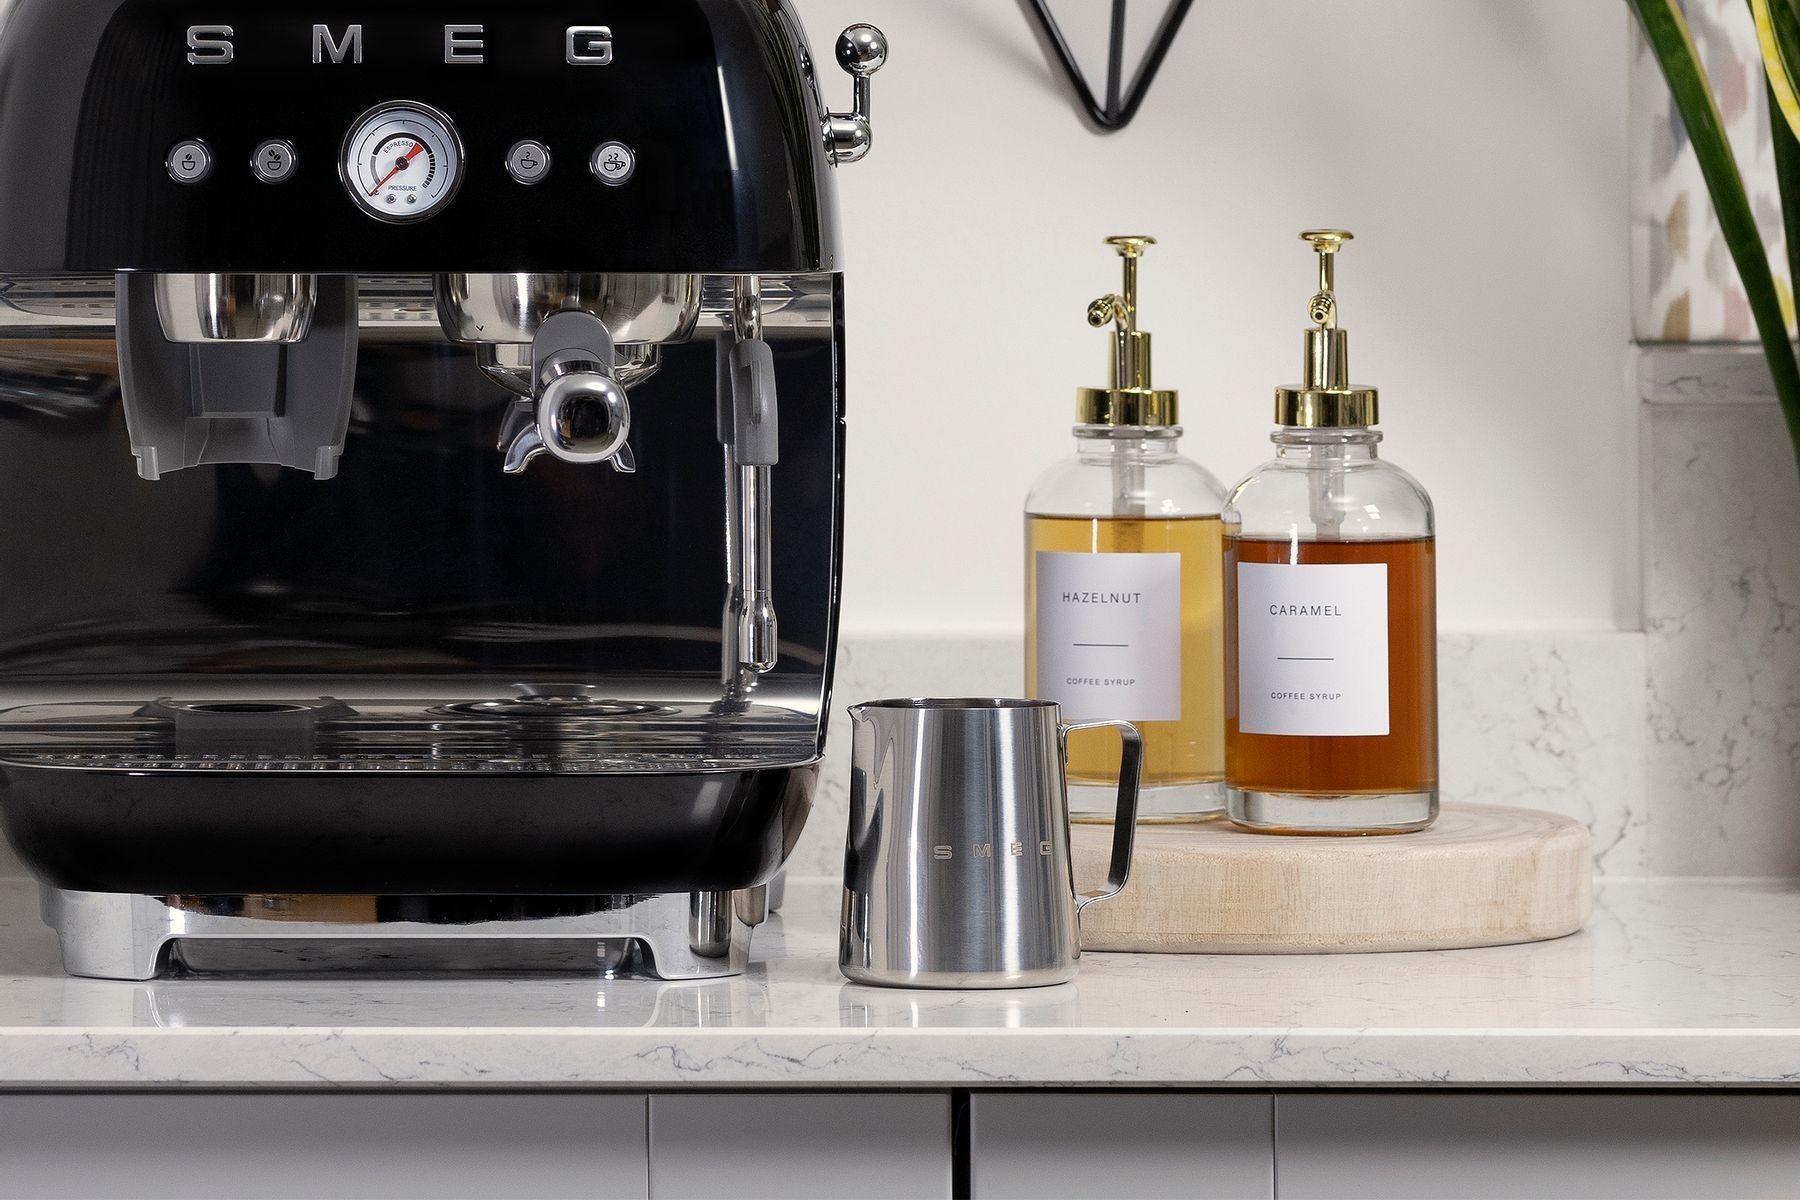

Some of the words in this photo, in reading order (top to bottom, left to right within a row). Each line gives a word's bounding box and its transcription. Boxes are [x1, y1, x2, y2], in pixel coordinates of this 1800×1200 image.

[187, 23, 613, 66] SMEG
[383, 140, 414, 154] ESPRESSO
[1062, 591, 1142, 605] HAZELNUT
[1269, 604, 1342, 617] CARAMEL
[1066, 677, 1101, 686] COFFEE
[1104, 678, 1136, 687] SYRUP
[1271, 692, 1306, 700] COFFEE
[1309, 692, 1342, 701] SYRUP
[933, 840, 1052, 860] SMEG
